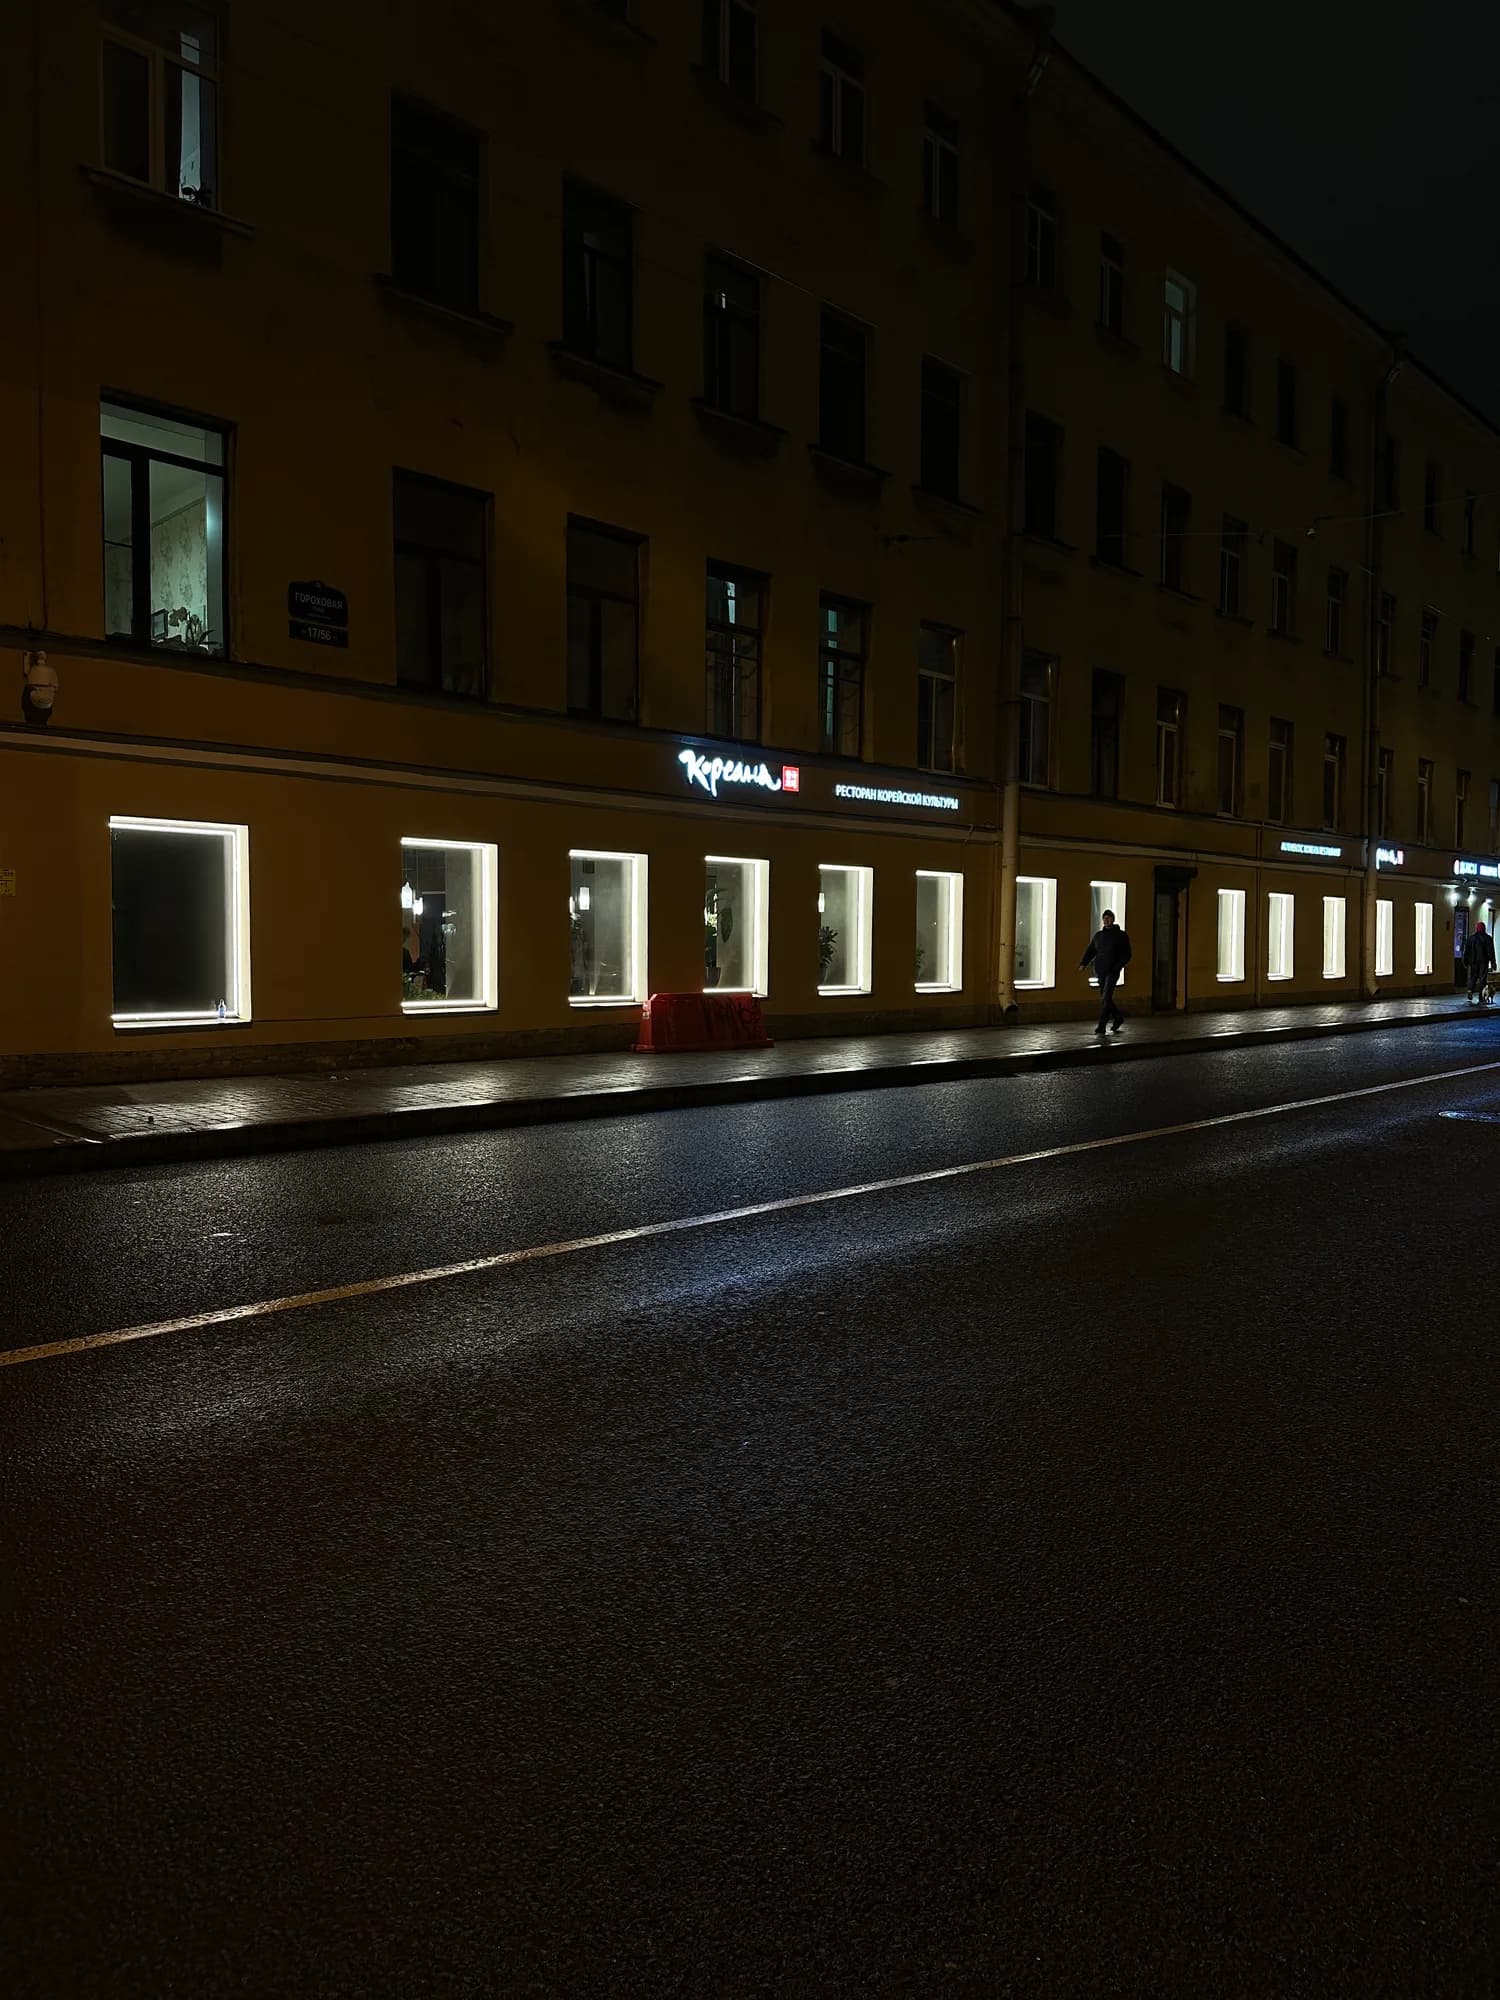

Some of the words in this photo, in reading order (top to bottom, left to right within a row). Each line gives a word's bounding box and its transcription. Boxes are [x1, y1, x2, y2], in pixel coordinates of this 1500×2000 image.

[295, 592, 344, 609] ГОРОХОВАЯ
[835, 784, 877, 801] РЕСТОРАН
[877, 789, 922, 806] КОРЕЙСКОЙ
[922, 794, 959, 810] КУЛЬТУРЫ
